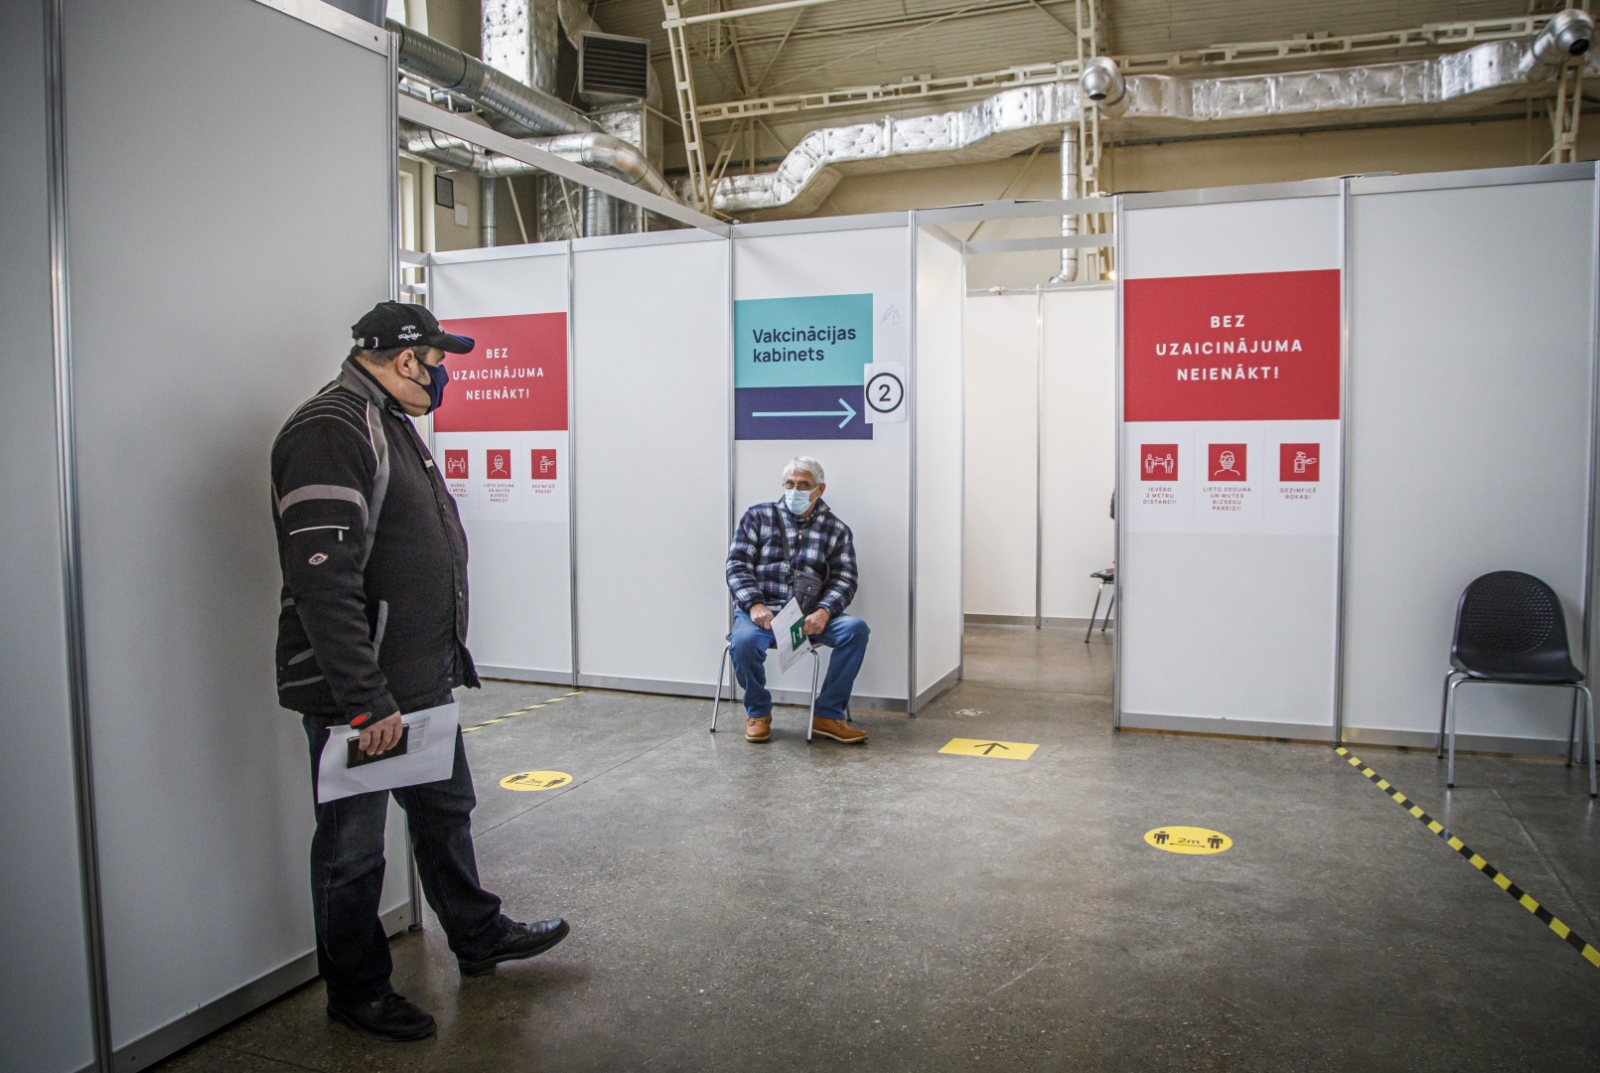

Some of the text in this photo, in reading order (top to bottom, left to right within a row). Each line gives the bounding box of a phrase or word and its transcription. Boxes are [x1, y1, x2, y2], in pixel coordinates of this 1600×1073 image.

[1210, 314, 1246, 328] BEZ
[752, 326, 856, 345] Vakcinācijas
[486, 348, 508, 358] BEZ
[753, 347, 825, 363] kabinets
[1156, 338, 1302, 356] UZAICINĀJUMA
[452, 366, 544, 380] UZAICINĀJUMA
[1177, 364, 1279, 381] NEIENĀKT!
[466, 386, 530, 400] NEIENĀKT!
[878, 384, 891, 402] 2
